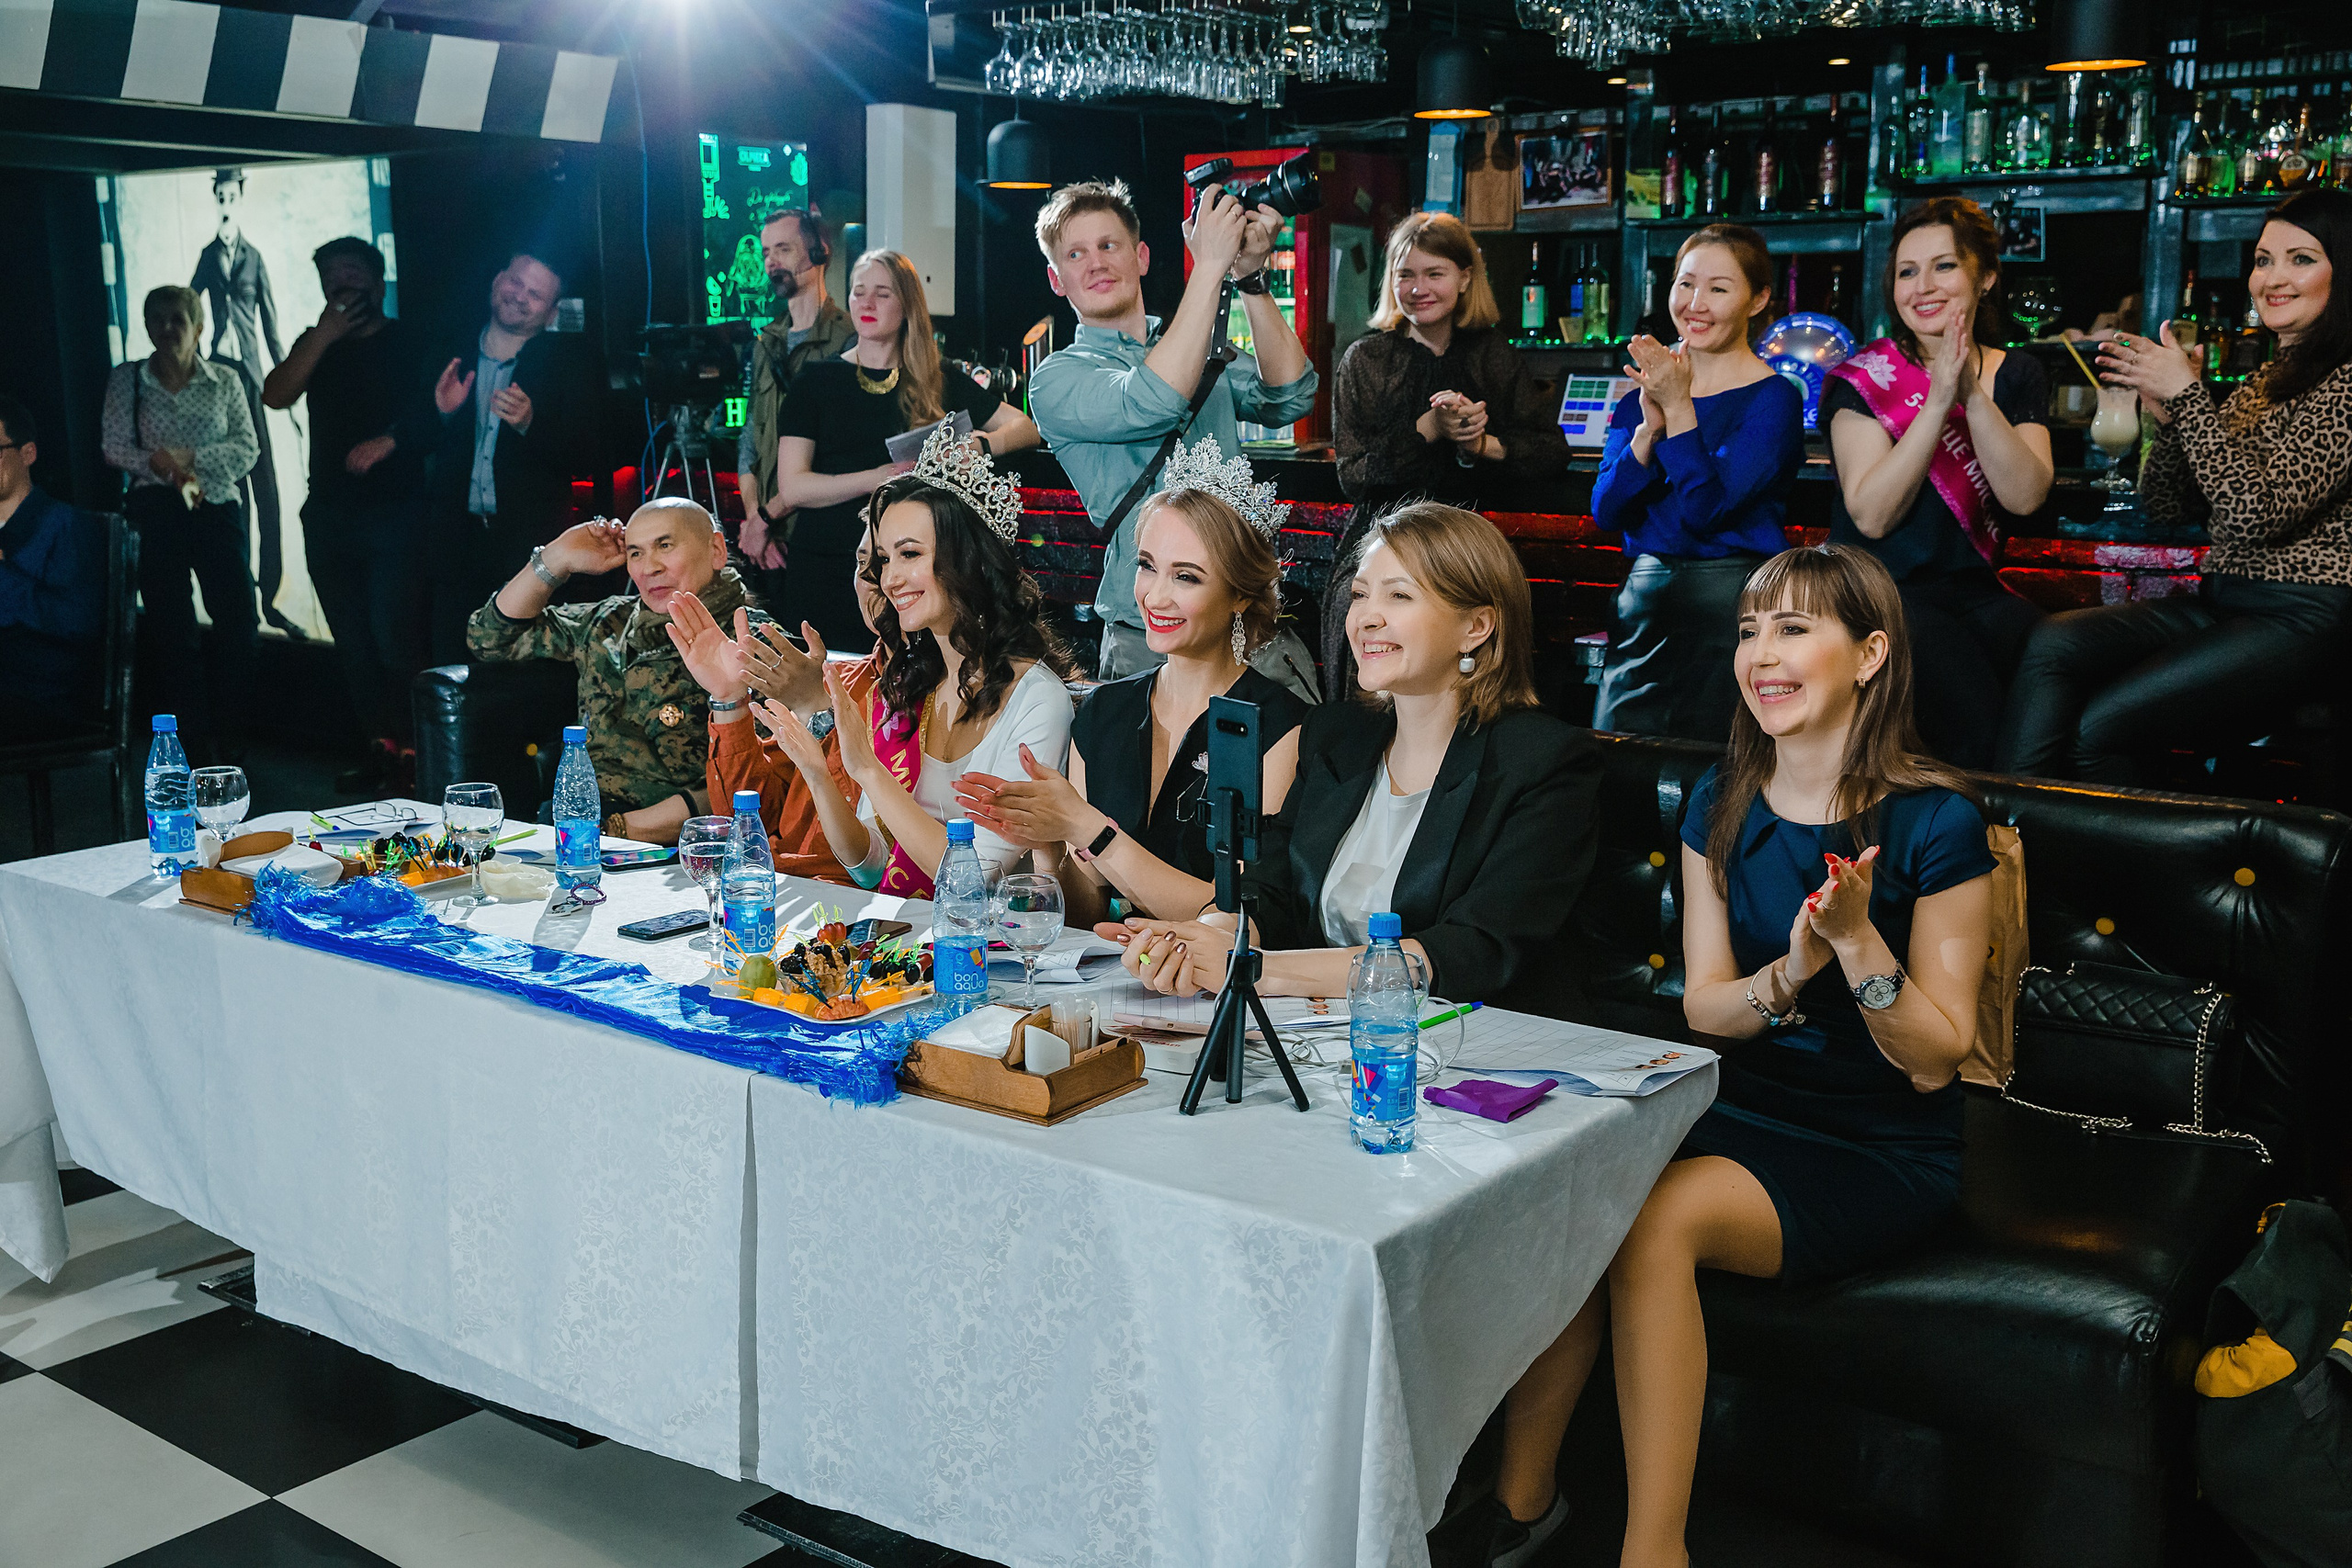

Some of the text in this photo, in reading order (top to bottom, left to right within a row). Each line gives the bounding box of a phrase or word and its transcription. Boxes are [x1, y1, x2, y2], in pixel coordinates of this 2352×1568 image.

[1941, 423, 1971, 461] ЦЕ
[955, 972, 978, 982] bon
[955, 980, 984, 992] aqua
